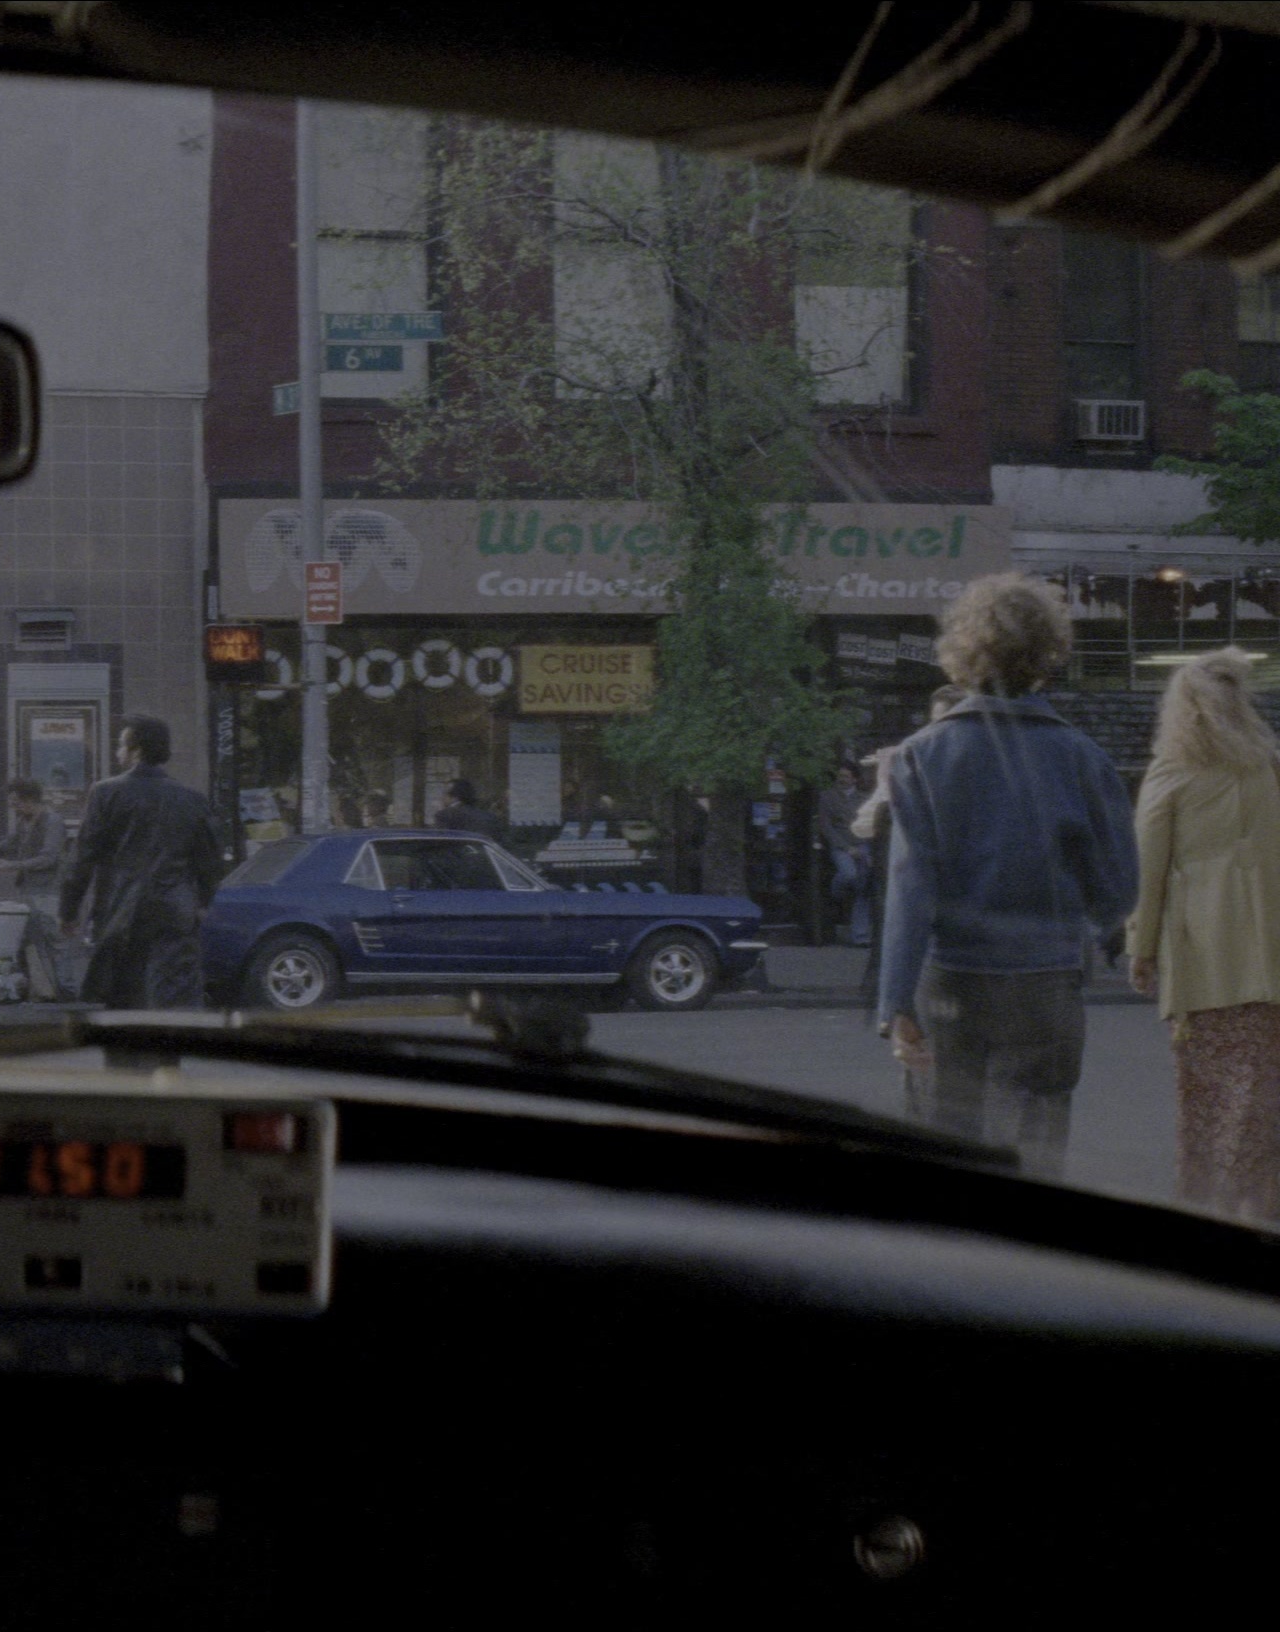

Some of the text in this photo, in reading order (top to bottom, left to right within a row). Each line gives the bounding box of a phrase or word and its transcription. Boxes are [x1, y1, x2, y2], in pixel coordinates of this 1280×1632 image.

[372, 313, 392, 330] OF
[405, 313, 434, 330] THE
[344, 347, 361, 370] 6
[477, 510, 964, 558] Wave Travel
[313, 566, 332, 579] NO
[834, 572, 964, 599] Charte
[540, 653, 632, 675] CRUISE
